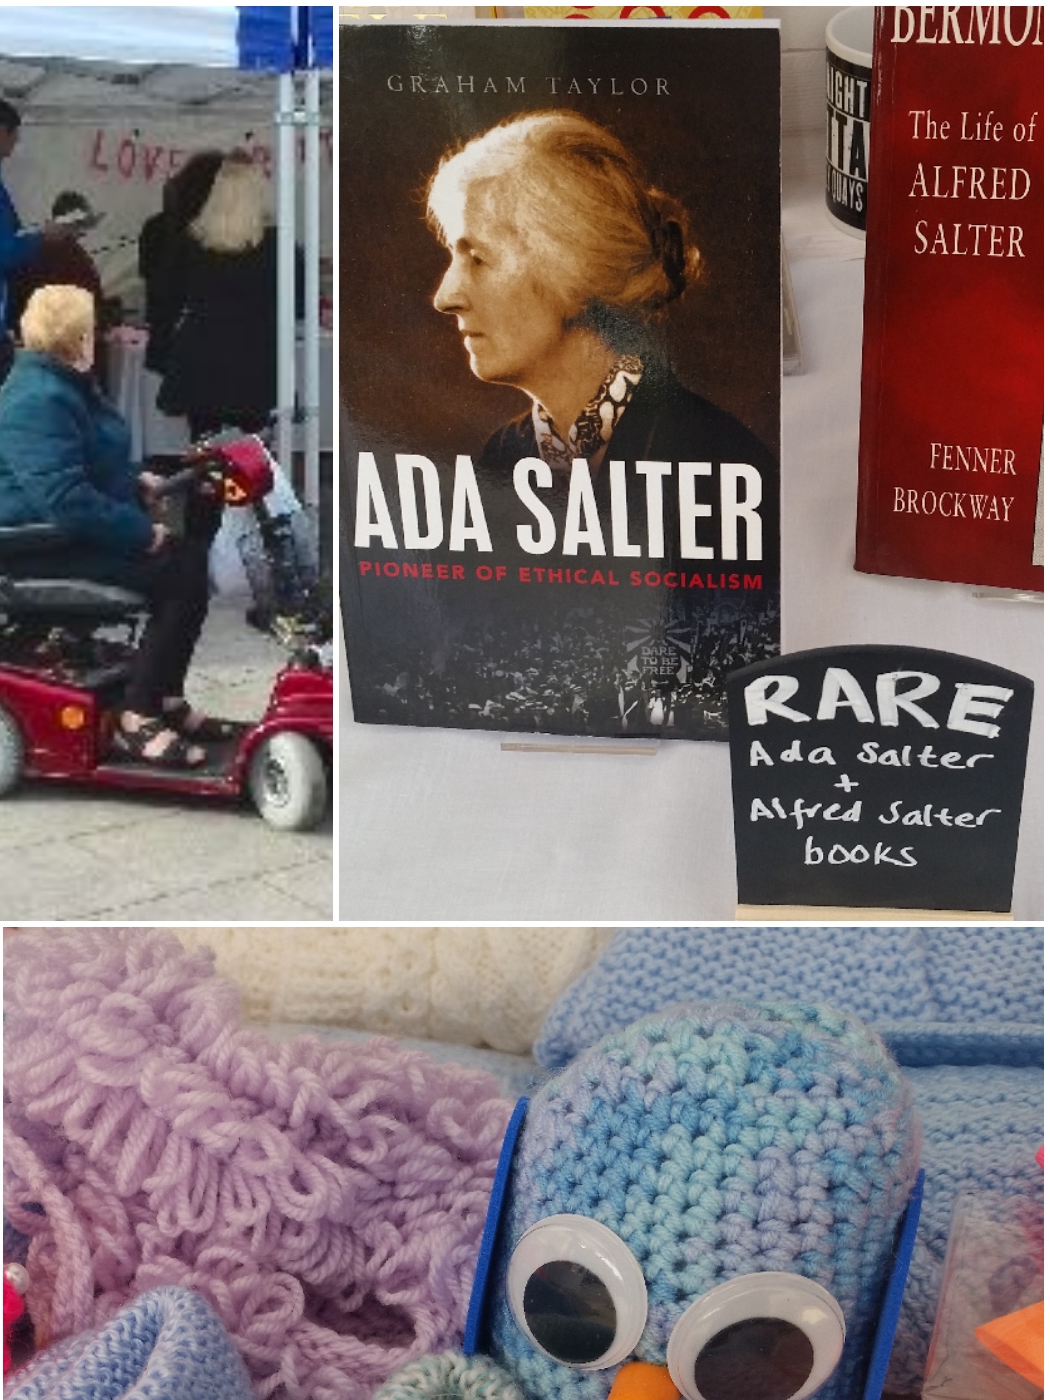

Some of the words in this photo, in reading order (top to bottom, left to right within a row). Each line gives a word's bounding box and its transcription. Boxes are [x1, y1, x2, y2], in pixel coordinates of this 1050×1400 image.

[387, 75, 527, 94] GRAHAM
[546, 76, 671, 96] TAYLOR
[826, 61, 868, 118] IGHT
[908, 109, 951, 140] The
[961, 110, 1004, 142] Life
[1013, 111, 1039, 142] of
[832, 171, 864, 212] QUAYS
[908, 162, 1031, 200] ALFRED
[914, 219, 1026, 258] SALTER
[930, 441, 1017, 476] FENNER
[354, 451, 493, 553] ADA
[513, 457, 762, 561] SALTER
[893, 486, 1014, 523] BROCKWAY
[359, 560, 467, 582] PIONEER
[476, 565, 508, 583] OF
[519, 567, 621, 587] ETHICAL
[629, 570, 763, 591] SOCIALISM
[641, 646, 677, 656] DARE
[641, 656, 658, 665] TO
[662, 657, 678, 665] BE
[642, 666, 675, 675] FREE
[743, 667, 1015, 739] RARE
[750, 741, 837, 767] Ada
[857, 741, 995, 770] Salter
[750, 797, 862, 825] Alfred
[879, 800, 1002, 829] Salter
[805, 836, 918, 868] books
